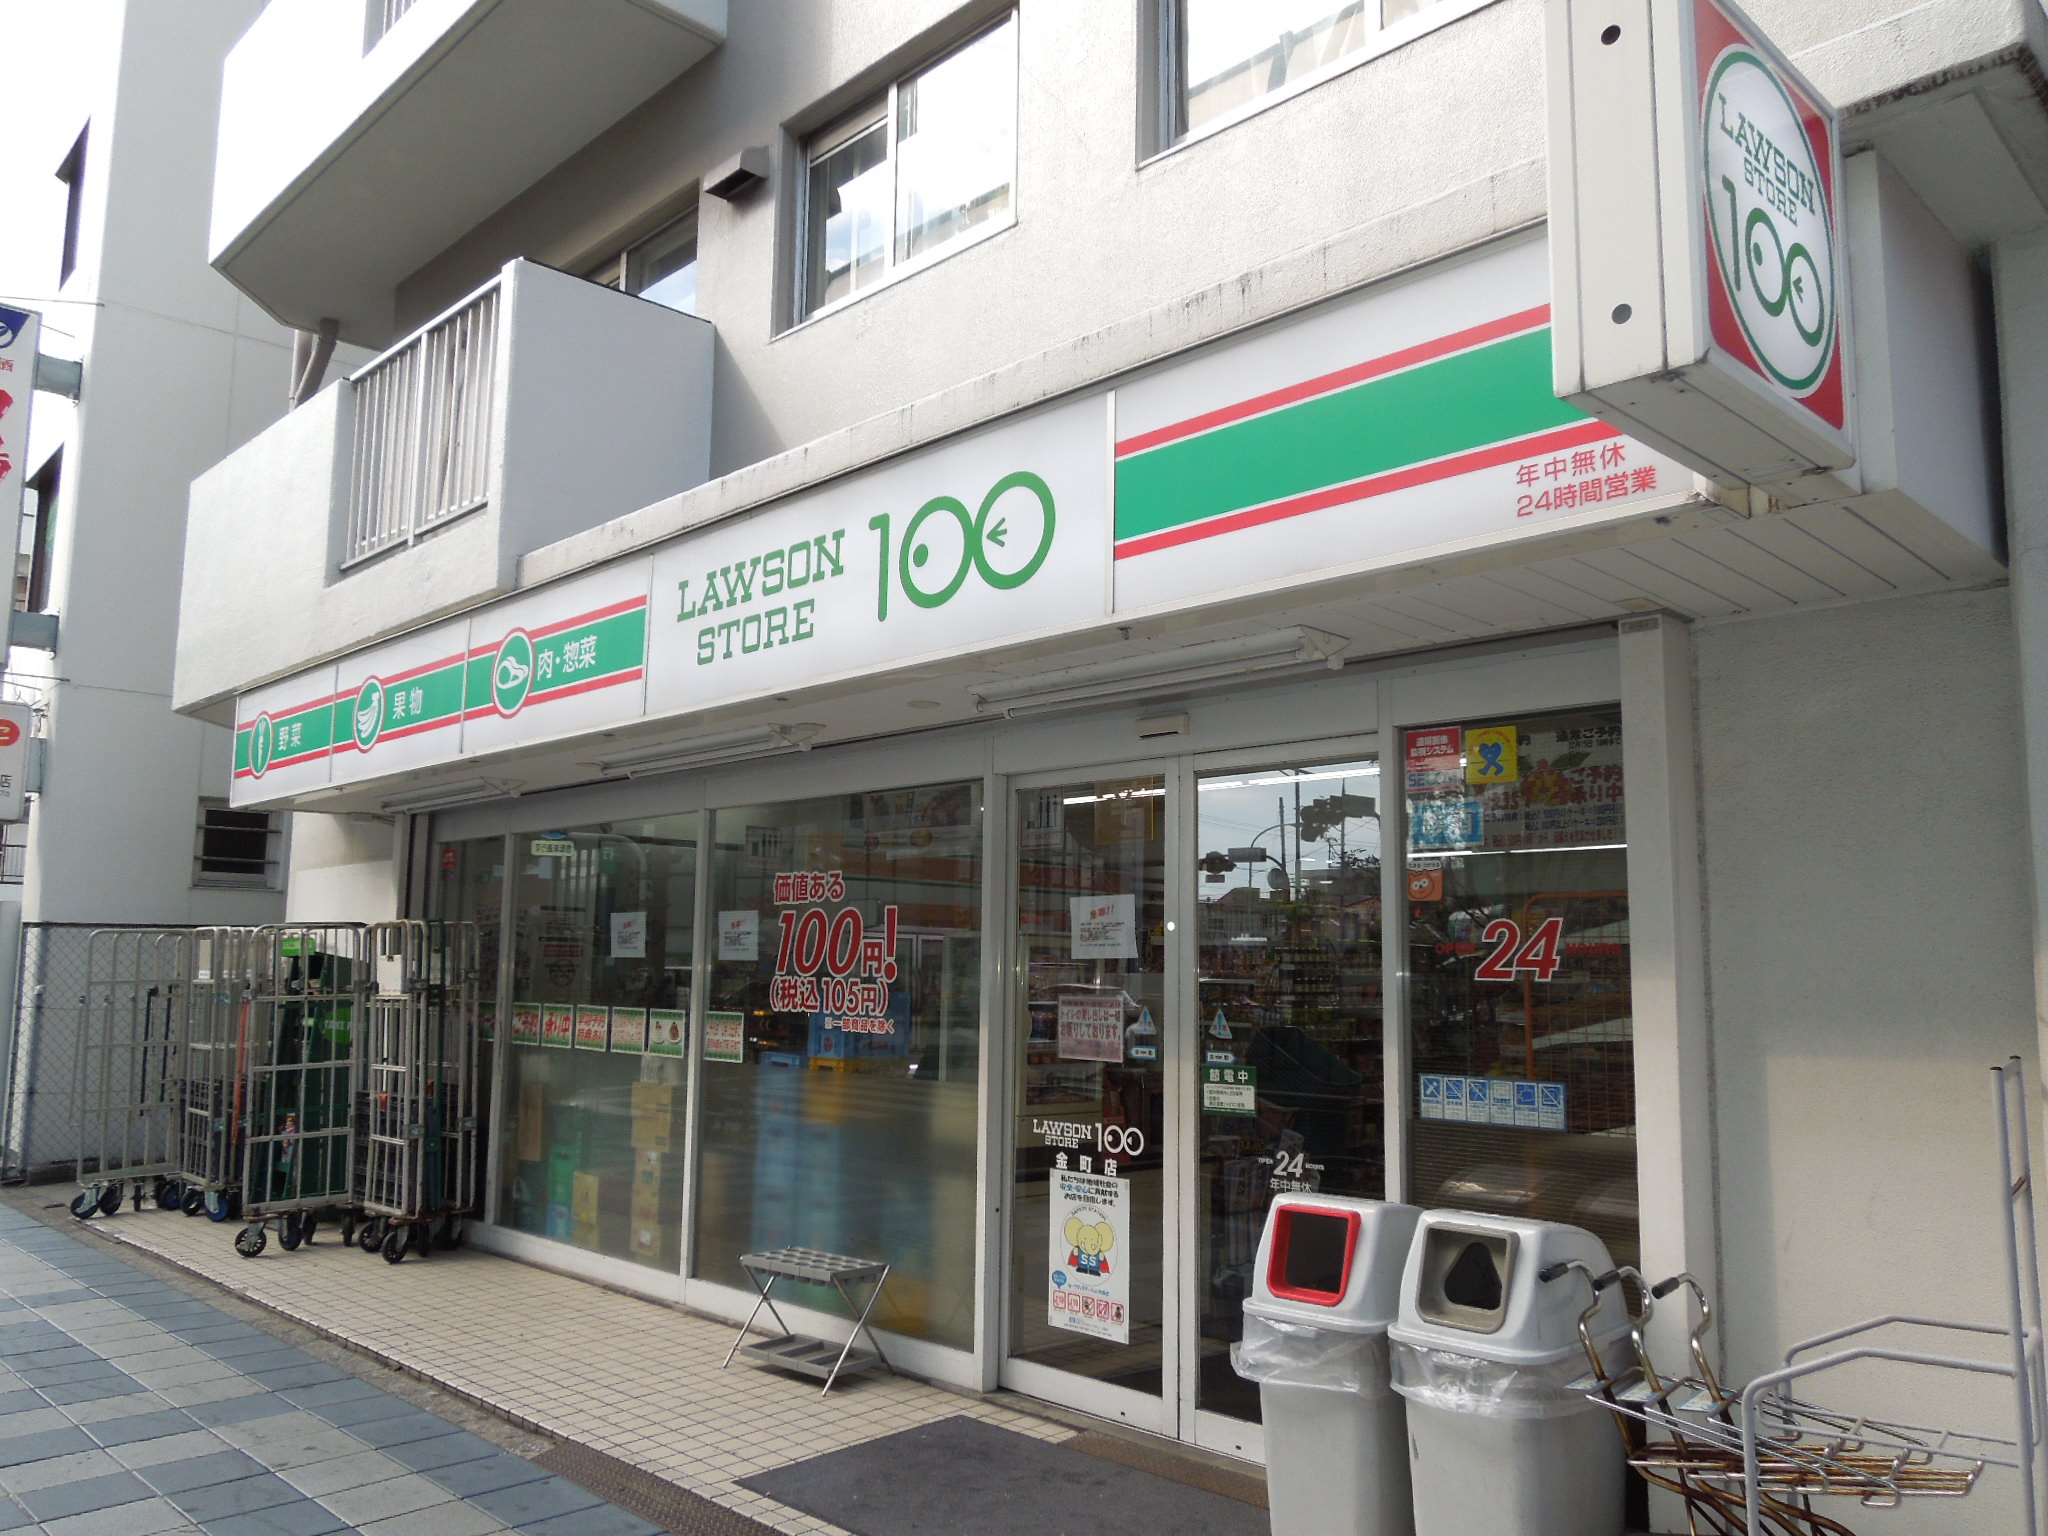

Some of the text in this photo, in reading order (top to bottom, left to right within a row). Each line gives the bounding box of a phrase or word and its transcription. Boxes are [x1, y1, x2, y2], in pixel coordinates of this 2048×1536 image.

[1718, 93, 1816, 215] LAWSON
[1743, 156, 1798, 227] STORE
[1722, 175, 1826, 348] 100
[1516, 442, 1627, 488] 年中無休
[1516, 465, 1657, 518] 24時間営業
[868, 471, 1056, 622] 100
[676, 529, 845, 623] LAWSON
[697, 598, 815, 666] STORE
[392, 688, 423, 720] 果物
[278, 723, 302, 751] 野菜
[774, 871, 846, 905] 価値ある
[1435, 917, 1623, 982] OPEN 24 HOURS
[1209, 1069, 1249, 1084] 節電中
[1032, 1119, 1092, 1140] LAWSON
[1045, 1135, 1079, 1149] STORE
[1094, 1122, 1145, 1156] 100
[1055, 1151, 1118, 1177] 金町店
[1273, 1150, 1304, 1178] 24
[1270, 1178, 1312, 1195] 年中無休
[1080, 1254, 1097, 1267] SS
